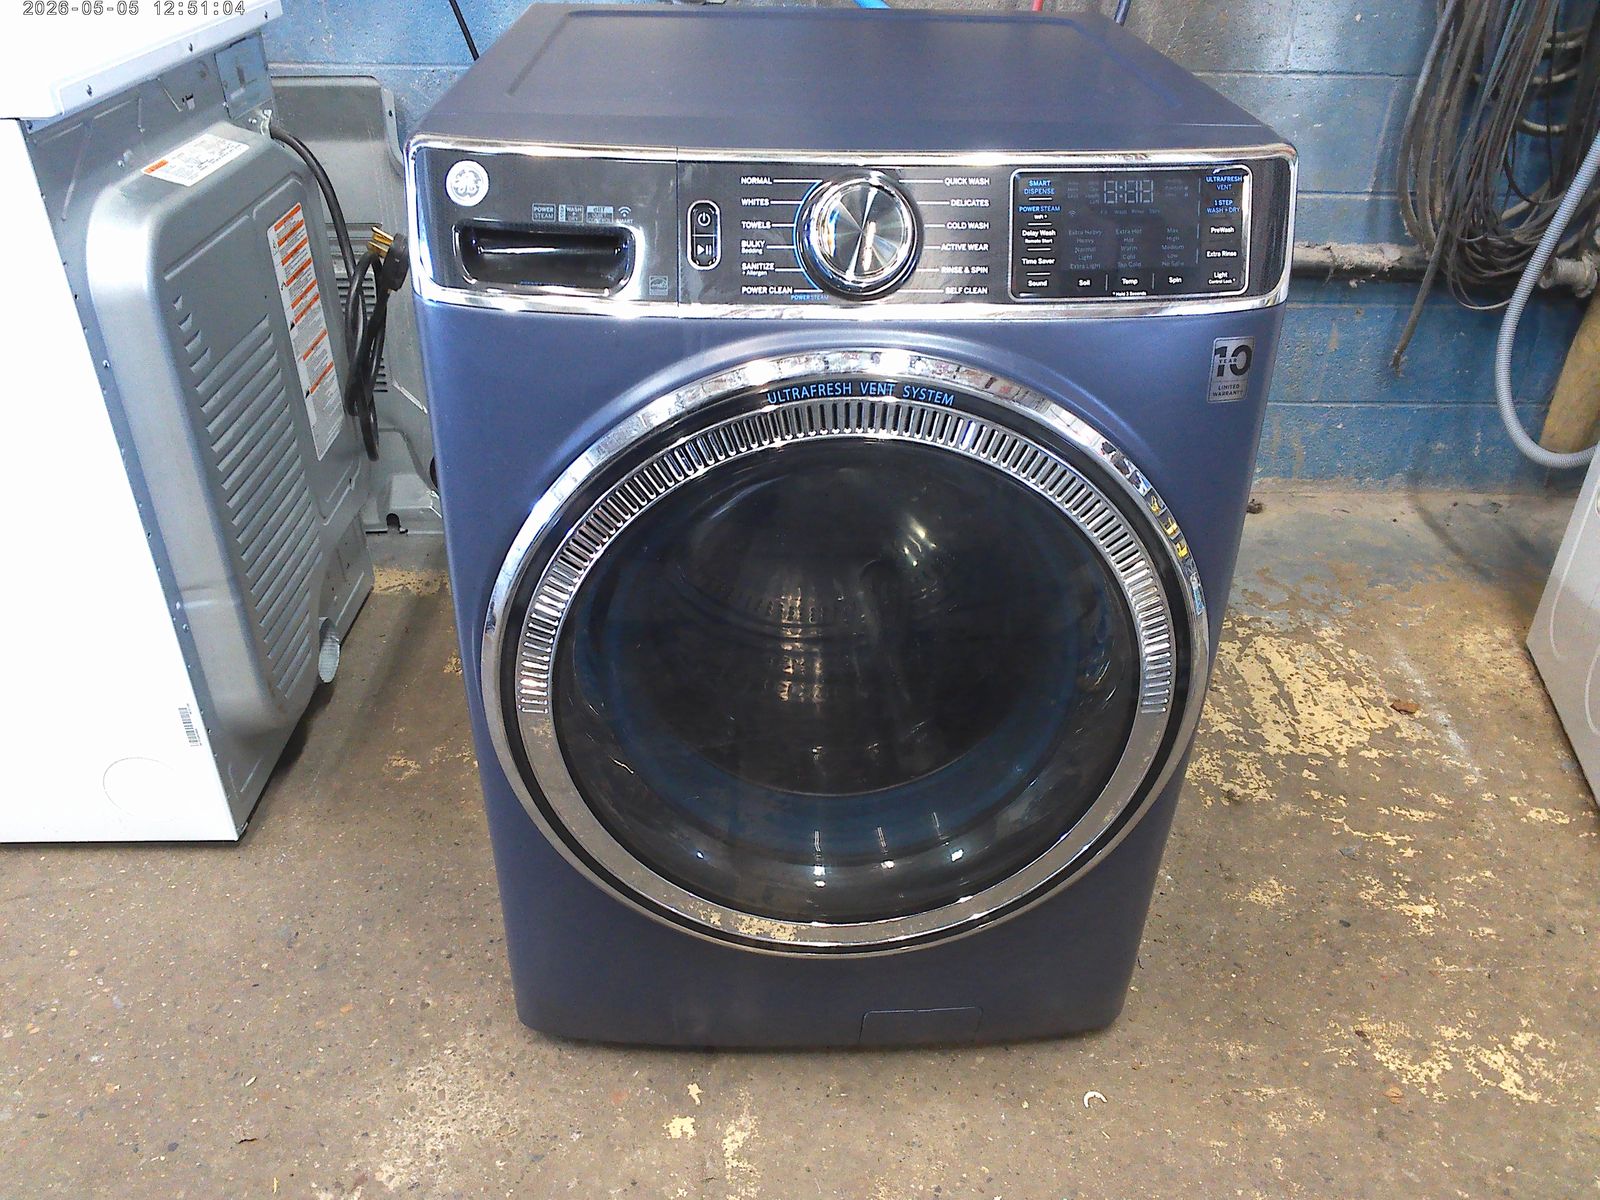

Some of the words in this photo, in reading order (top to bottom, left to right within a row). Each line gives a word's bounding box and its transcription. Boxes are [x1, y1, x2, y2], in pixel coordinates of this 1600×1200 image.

[741, 176, 772, 185] NORMAL
[944, 177, 968, 186] QUICK
[968, 177, 990, 185] WASH
[1023, 187, 1055, 195] DISPENSE
[741, 198, 770, 206] WHITES
[950, 199, 990, 207] DELICATES
[741, 221, 771, 229] TOWELS
[946, 221, 967, 230] COLD
[967, 221, 990, 230] WASH
[1021, 229, 1039, 237] Delay
[1039, 229, 1056, 237] Wash
[1210, 226, 1235, 234] PreWash
[741, 239, 766, 248] BULKY
[941, 243, 967, 251] ACTIVE
[967, 243, 989, 251] WEAR
[1206, 250, 1221, 258] Extra
[1221, 250, 1237, 258] Rinse
[1037, 257, 1055, 265] Saver
[741, 262, 775, 271] SANITIZE
[941, 266, 963, 274] RINSE
[970, 266, 989, 274] SPIN
[1078, 279, 1091, 287] Soil
[1168, 276, 1183, 284] Spin
[741, 286, 768, 295] POWER
[768, 286, 793, 295] CLEAN
[945, 286, 963, 295] SELF
[963, 286, 988, 295] CLEAN
[1214, 344, 1253, 377] 10
[767, 382, 852, 404] ULTRAFRESH
[860, 382, 896, 397] VENT
[902, 385, 955, 406] SYSTEM
